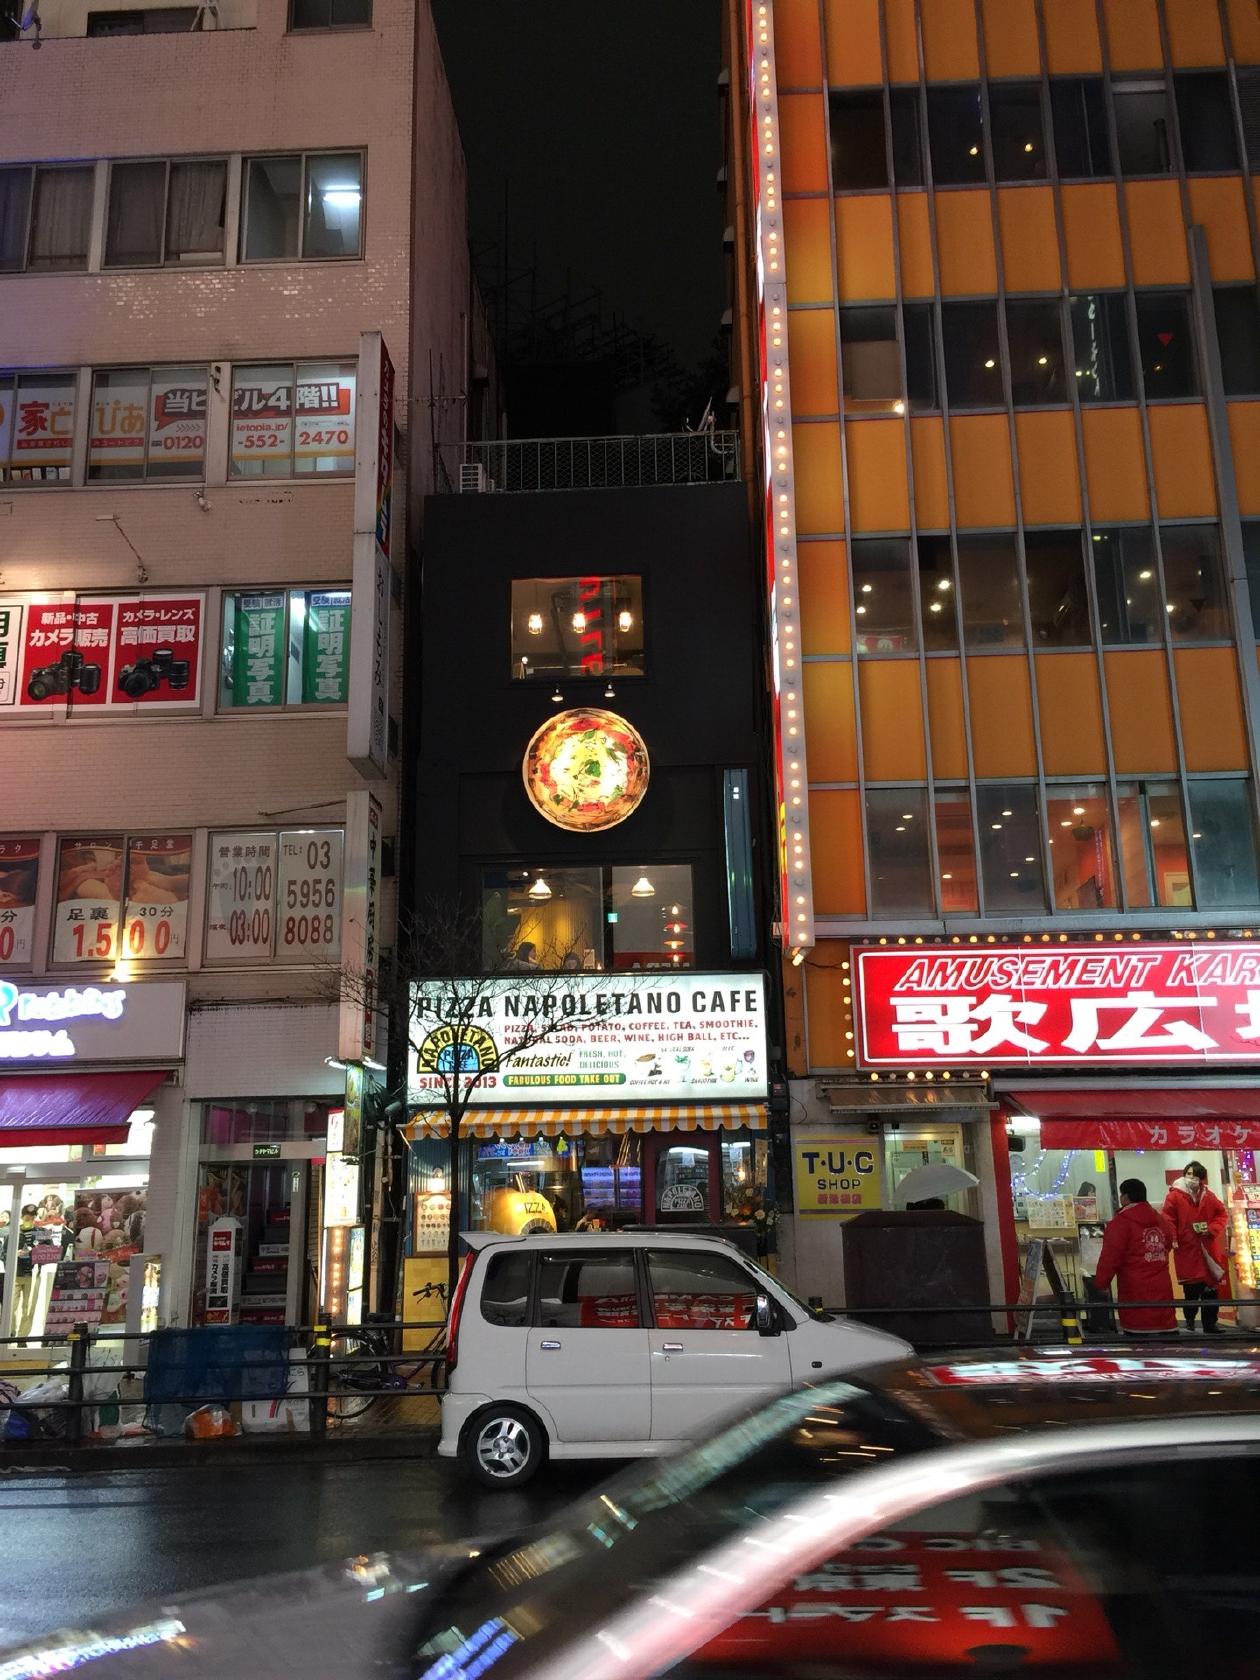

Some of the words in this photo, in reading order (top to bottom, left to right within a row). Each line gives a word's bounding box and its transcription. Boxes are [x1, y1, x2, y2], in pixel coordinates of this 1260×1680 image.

[121, 625, 195, 645] 高価買取
[247, 612, 276, 704] 証明写真
[315, 610, 345, 699] 証明写真
[219, 845, 271, 858] 営業時間
[307, 841, 331, 869] 03
[233, 865, 272, 902] 10:00
[287, 878, 335, 909] 5956
[66, 907, 109, 921] 足裏
[229, 908, 270, 945] 03:00
[285, 914, 334, 945] 8088
[893, 954, 1163, 991] AMUSEMENT
[417, 995, 493, 1019] PIZZA
[504, 991, 681, 1018] NAPOLETANO
[692, 990, 758, 1014] CAFE
[658, 1033, 684, 1042] HIGH
[505, 1051, 573, 1069] Fantastic!
[508, 1074, 551, 1085] FABULOUS
[554, 1074, 577, 1085] FOOD
[579, 1073, 600, 1084] TAKE
[603, 1073, 620, 1084] OUT
[1151, 1125, 1252, 1145] カラオケ
[817, 1178, 861, 1190] SHOP
